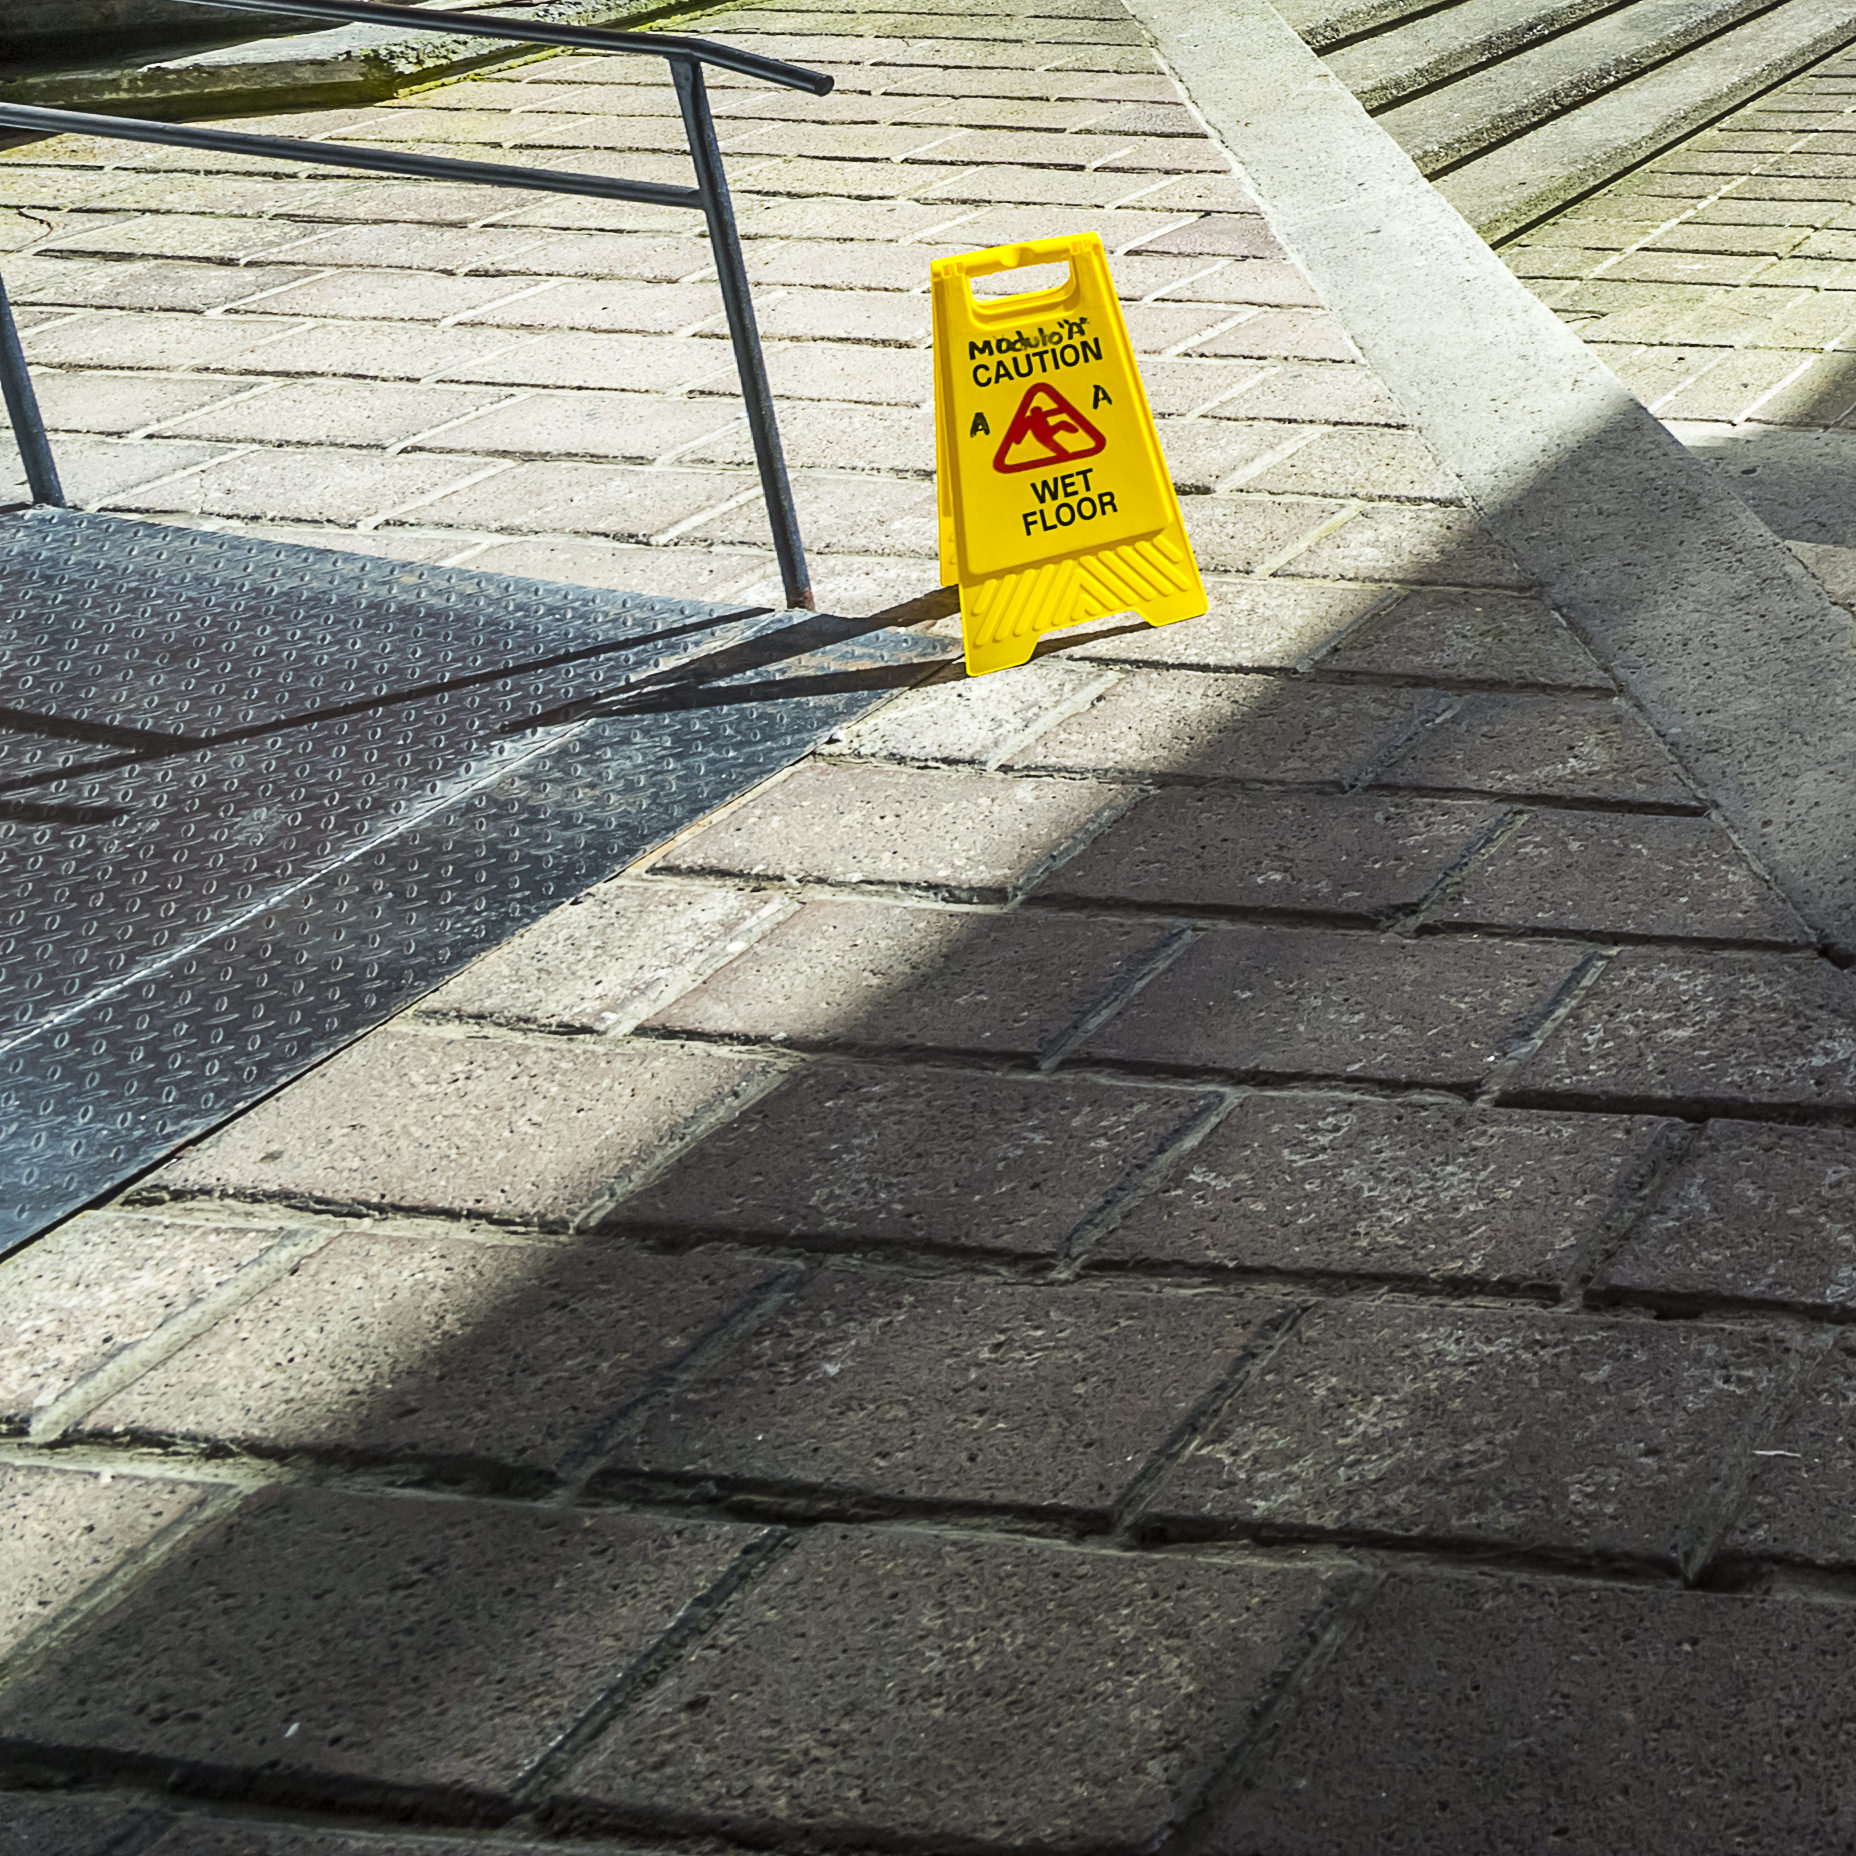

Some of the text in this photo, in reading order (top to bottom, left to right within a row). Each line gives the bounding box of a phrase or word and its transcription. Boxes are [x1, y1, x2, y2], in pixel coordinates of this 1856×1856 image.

[972, 336, 1104, 388] CAUTION
[1092, 384, 1113, 410] A
[969, 411, 991, 439] A
[1029, 467, 1094, 505] WET
[1021, 491, 1118, 537] FLOOR
